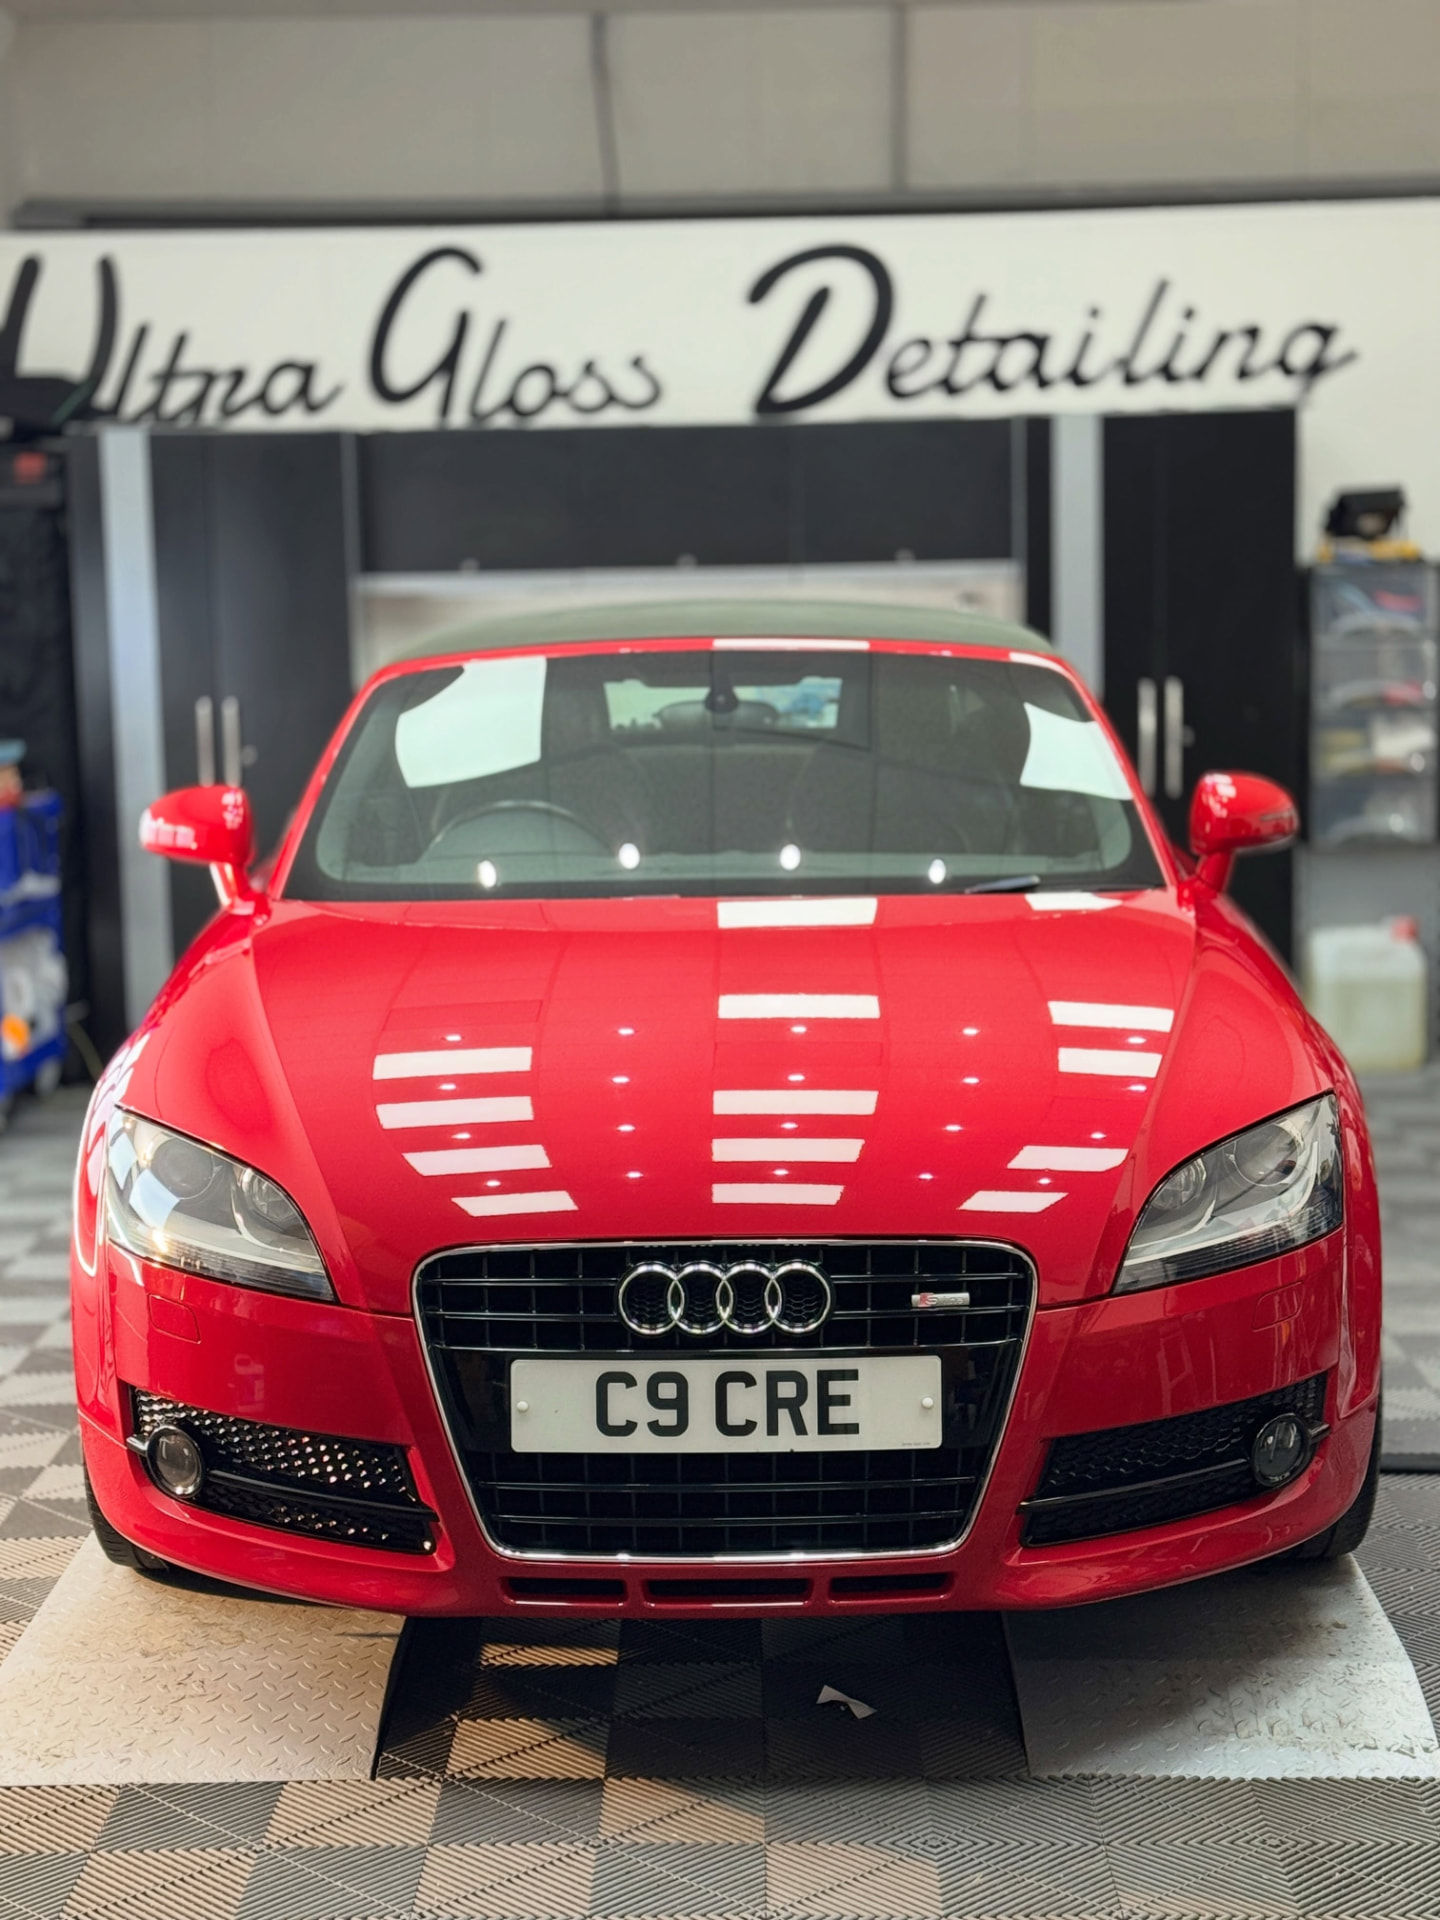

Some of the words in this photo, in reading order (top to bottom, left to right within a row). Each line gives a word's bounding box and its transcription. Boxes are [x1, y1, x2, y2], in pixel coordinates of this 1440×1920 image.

[369, 246, 662, 425] Gloss
[747, 244, 1358, 413] Detailing
[596, 1371, 689, 1437] C9
[715, 1369, 860, 1436] CRE
